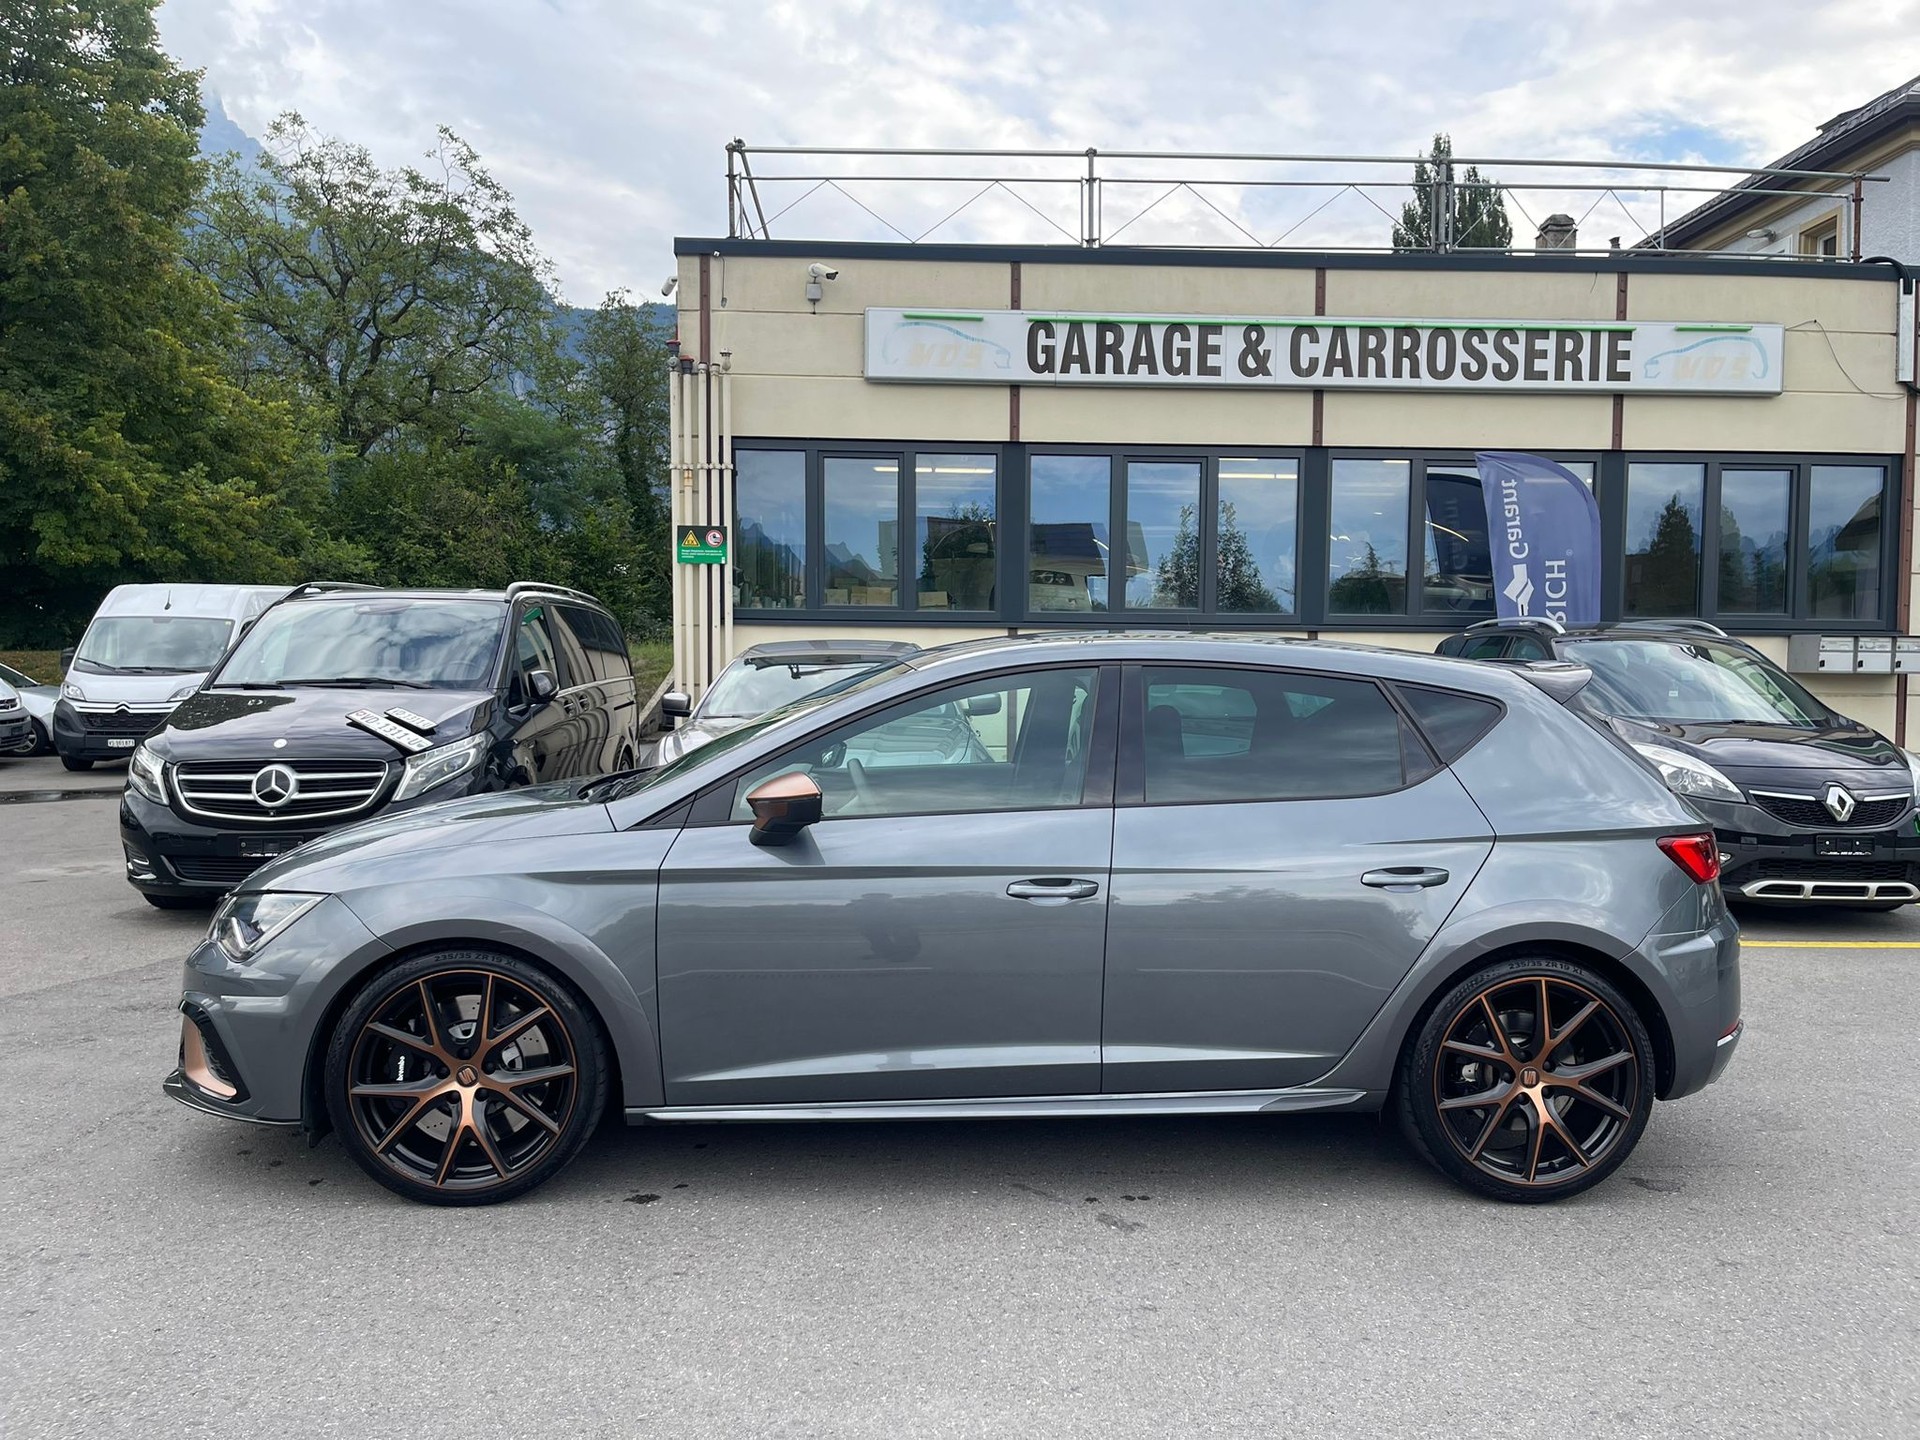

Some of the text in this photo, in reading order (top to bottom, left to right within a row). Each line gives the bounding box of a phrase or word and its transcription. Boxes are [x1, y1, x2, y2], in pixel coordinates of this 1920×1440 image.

[1026, 321, 1634, 383] GARAGE & CARROSSERIE
[433, 952, 472, 962] 235/35
[474, 953, 489, 961] ZR
[1507, 960, 1543, 970] 235/35
[1545, 960, 1559, 969] ZR
